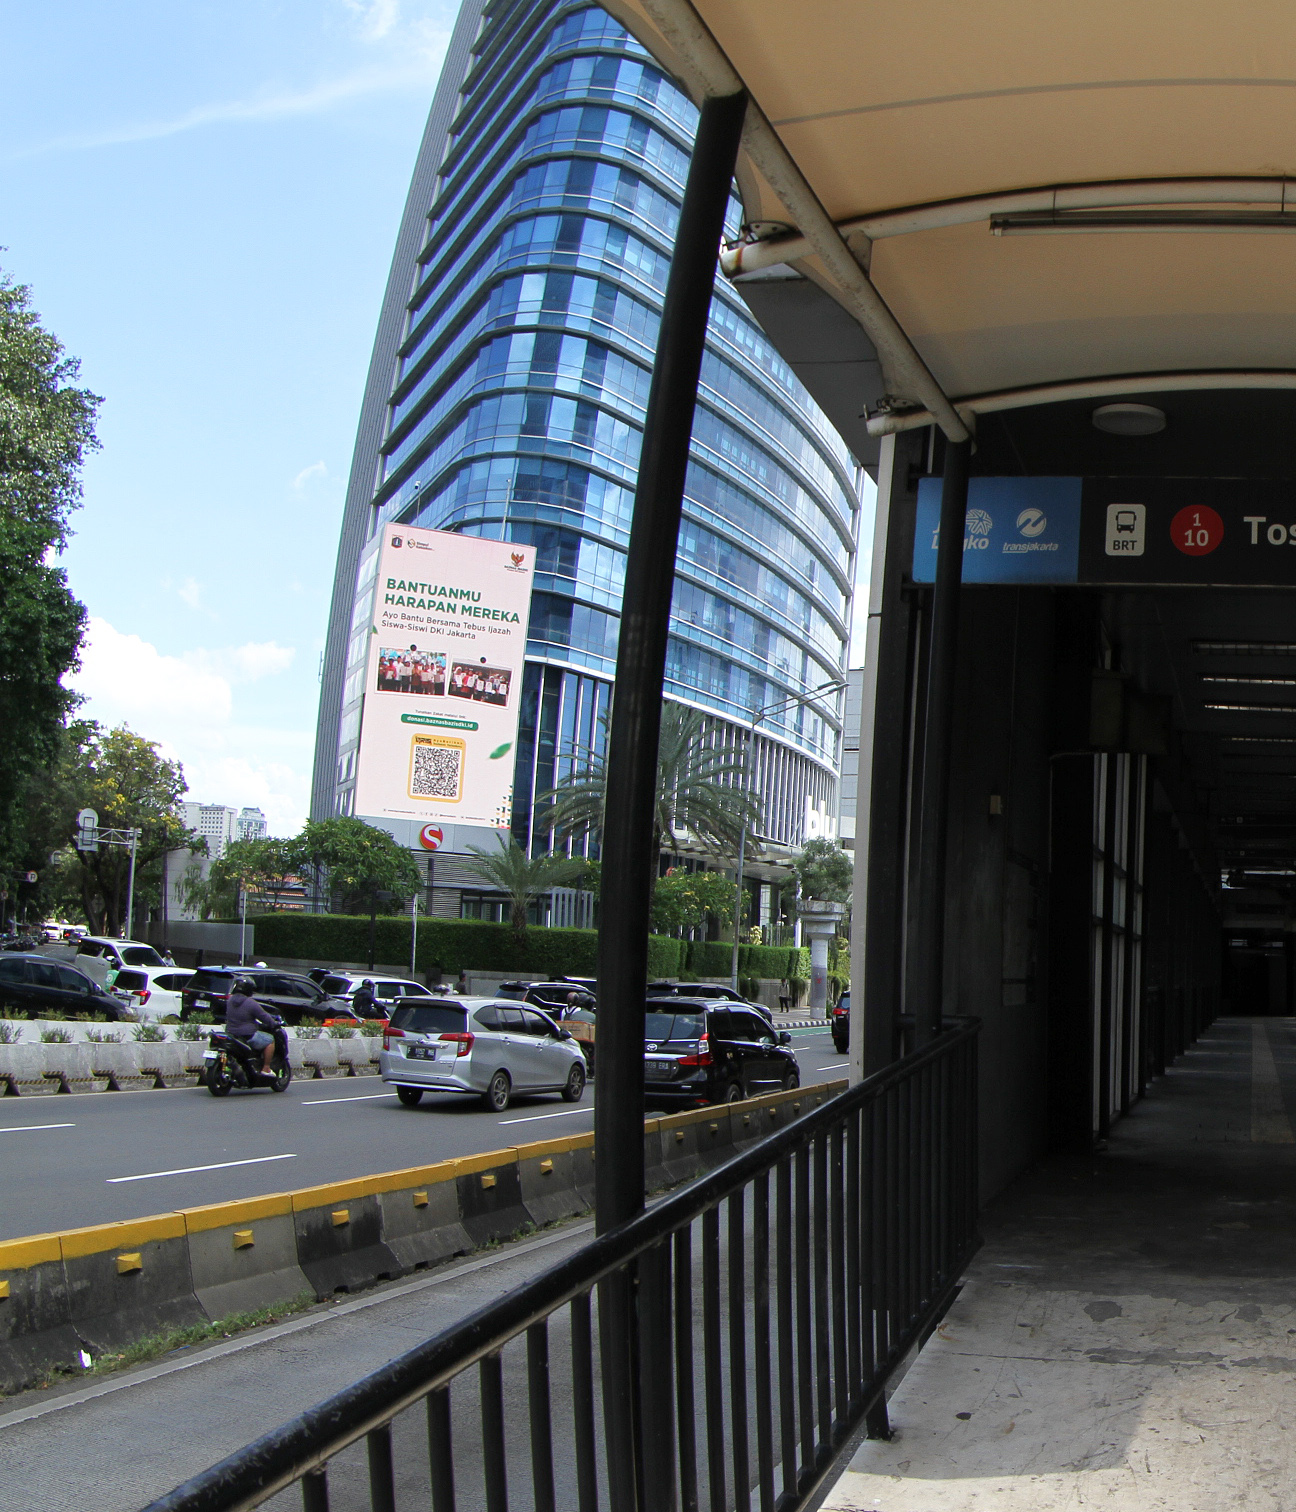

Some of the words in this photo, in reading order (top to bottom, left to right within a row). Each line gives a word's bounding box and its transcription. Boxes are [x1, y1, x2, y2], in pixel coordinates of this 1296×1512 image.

[1192, 513, 1202, 527] 1
[1112, 540, 1138, 551] BRT
[1184, 529, 1210, 547] 10
[1002, 542, 1060, 554] transjakarta
[386, 578, 482, 603] BANTUANMU
[384, 593, 458, 614] HARAPAN
[460, 604, 521, 624] MEREKA
[381, 620, 428, 633] Siswa-Siswi
[430, 626, 445, 636] DKI
[446, 629, 477, 640] Jakarta
[382, 610, 399, 620] Ayo
[400, 613, 425, 623] Bantu
[426, 617, 462, 628] Bersama
[463, 622, 486, 632] Tebus
[487, 625, 512, 636] Ijazah
